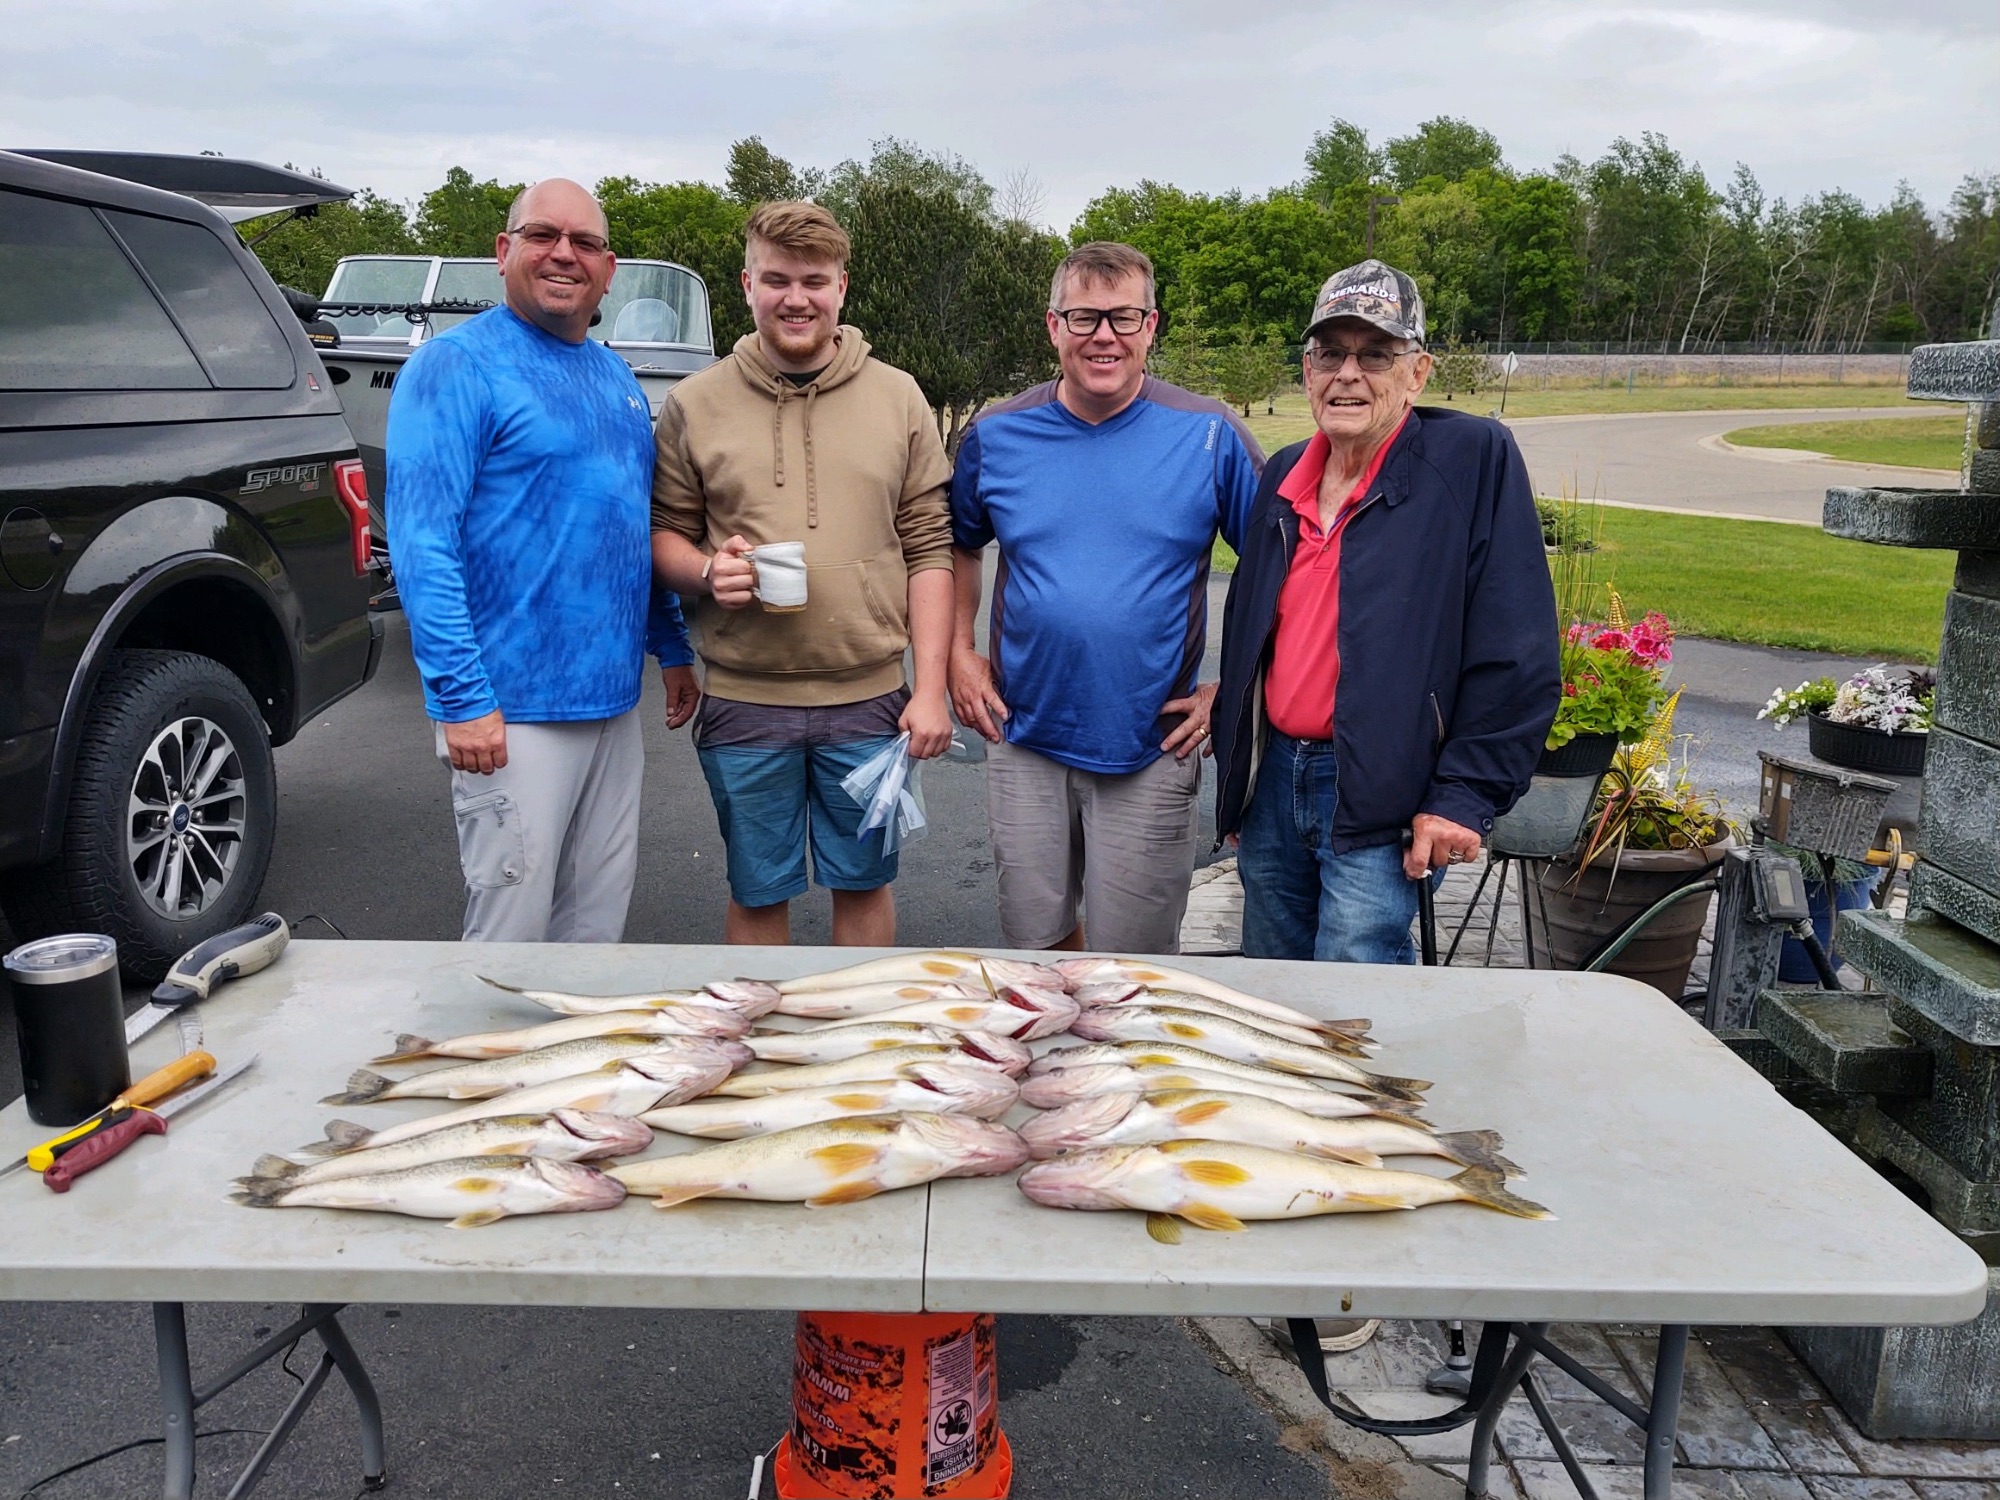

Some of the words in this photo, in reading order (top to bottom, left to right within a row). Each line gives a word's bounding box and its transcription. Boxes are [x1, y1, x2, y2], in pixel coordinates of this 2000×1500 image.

[1328, 284, 1398, 303] MENARDS
[370, 370, 397, 389] MN
[1204, 419, 1218, 451] Reebok
[238, 461, 328, 495] SPORT
[934, 1460, 968, 1481] WARNING
[943, 1452, 964, 1469] AVISO
